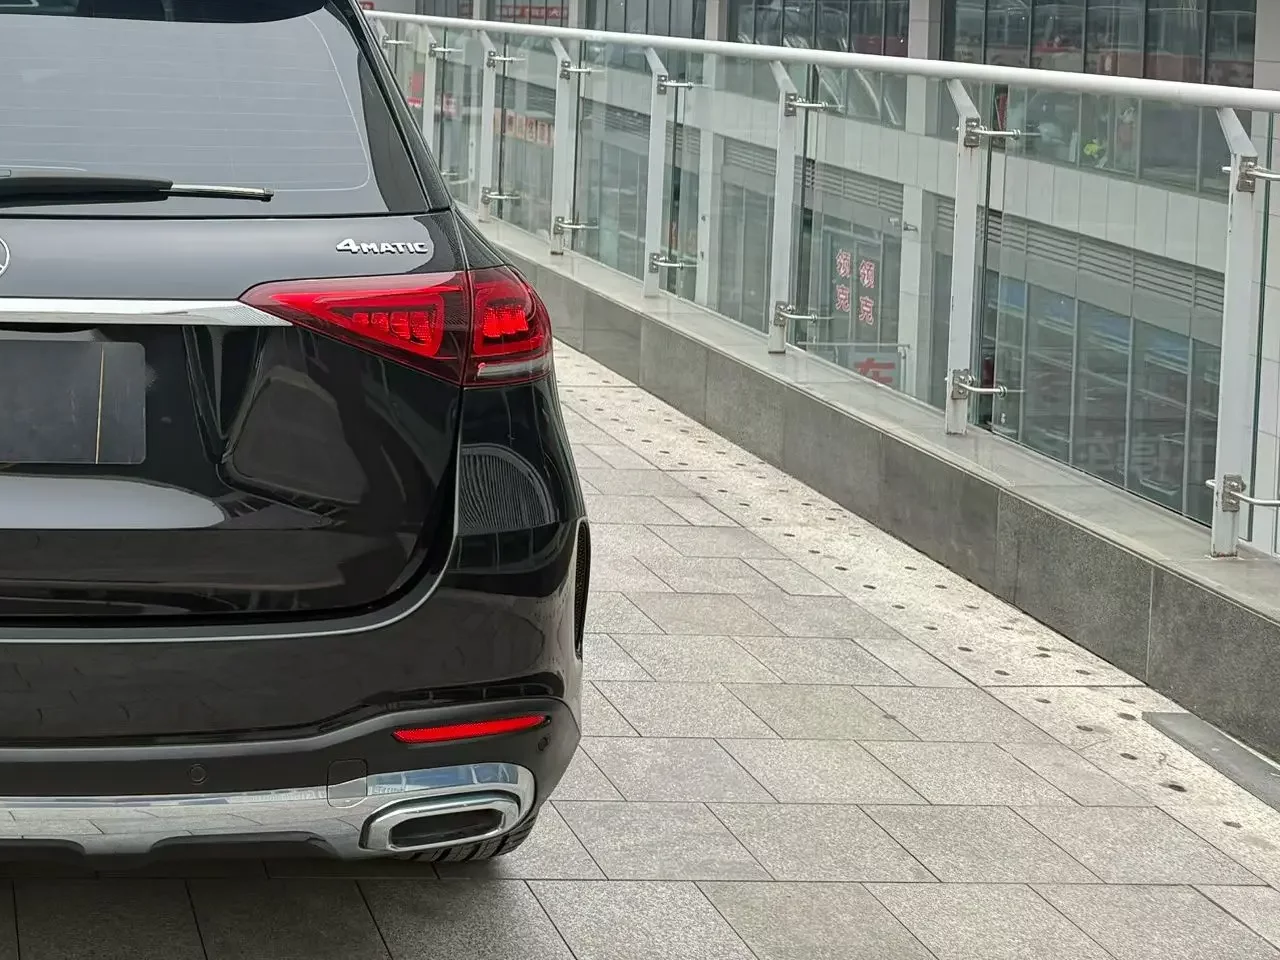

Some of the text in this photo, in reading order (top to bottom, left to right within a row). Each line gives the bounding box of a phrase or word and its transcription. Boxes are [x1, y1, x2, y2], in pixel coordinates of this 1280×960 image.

[336, 238, 429, 254] 4MATIC
[835, 248, 851, 313] 领克
[858, 259, 875, 326] 领克
